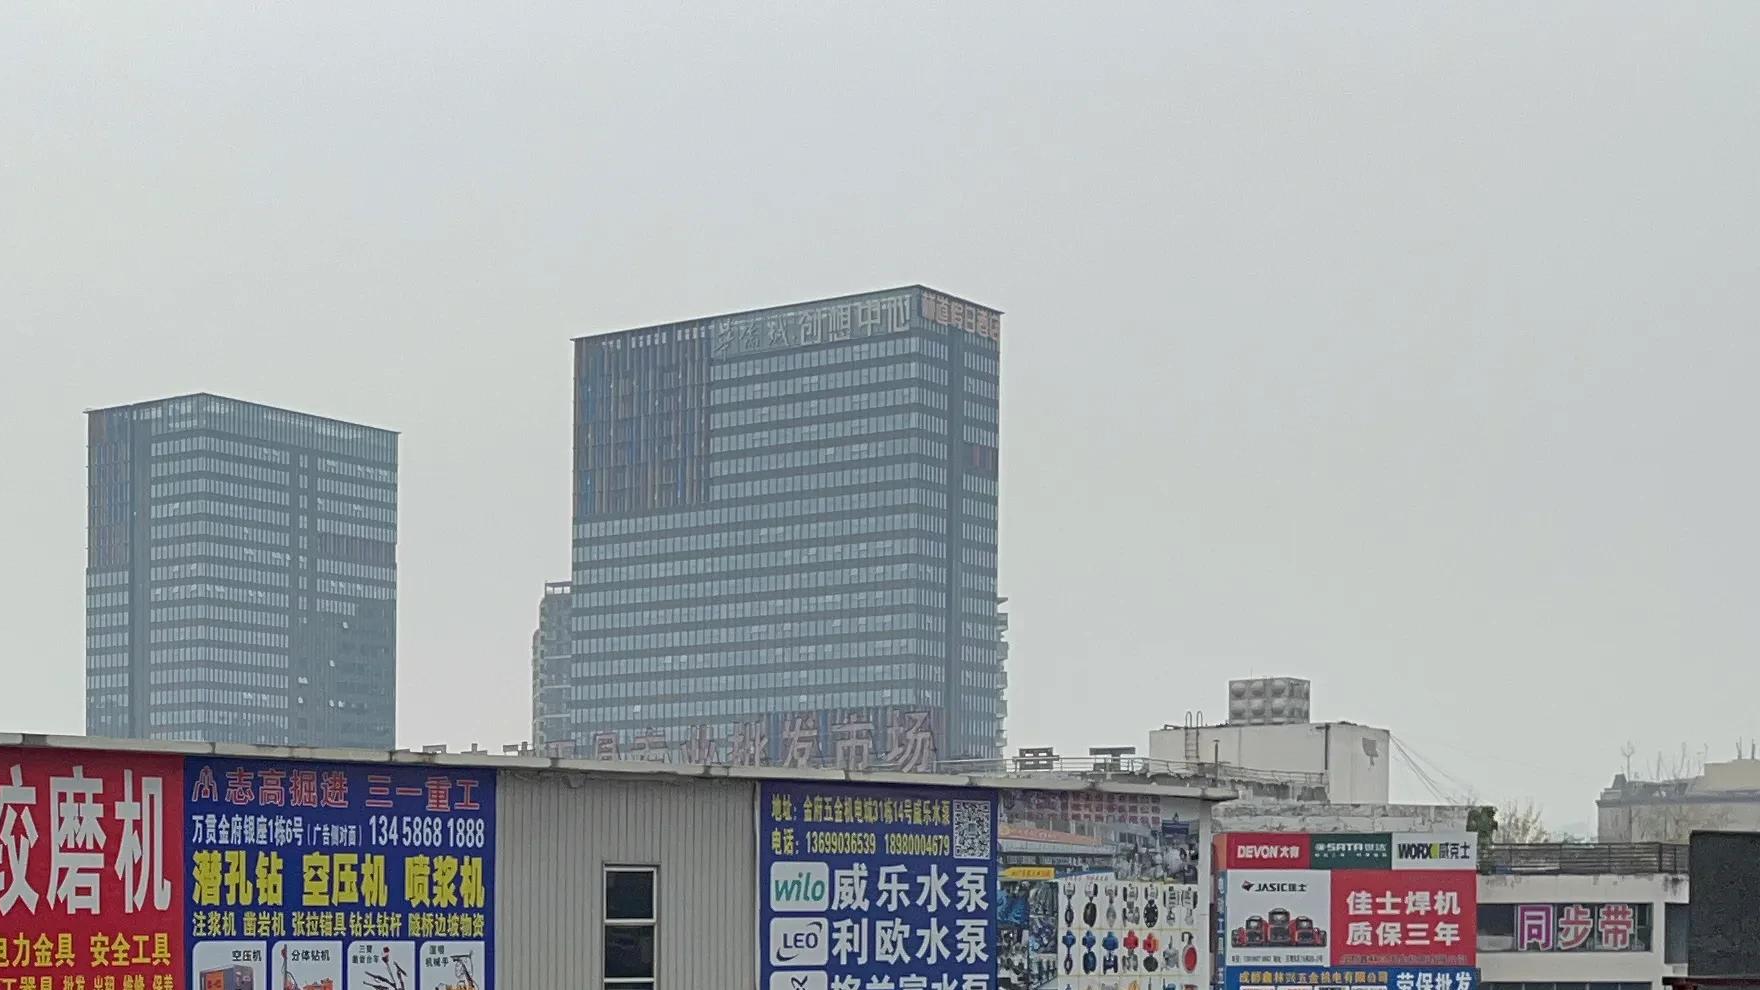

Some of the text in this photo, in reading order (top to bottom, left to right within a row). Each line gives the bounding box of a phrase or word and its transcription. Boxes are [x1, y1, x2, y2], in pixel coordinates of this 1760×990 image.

[365, 774, 481, 812] 三一重工
[192, 814, 304, 847] 万贯金府银座1栋6号
[369, 815, 398, 847] 134
[402, 816, 442, 847] 5868
[447, 818, 485, 848] 1888
[1237, 844, 1277, 859] DEVON
[1398, 843, 1433, 859] WORX
[192, 850, 485, 908] 潜孔钻 空压机 喷浆机
[774, 872, 826, 901] wilo
[831, 863, 989, 912] 威乐水泵
[1255, 882, 1288, 892] JASIC
[1346, 891, 1460, 915] 佳士焊机
[192, 911, 237, 937] 注浆机
[1346, 922, 1460, 946] 质保三年
[1517, 903, 1634, 951] 同步带
[90, 933, 171, 967] 安全工具
[783, 933, 818, 949] LEO
[831, 918, 989, 964] 利欧水泵
